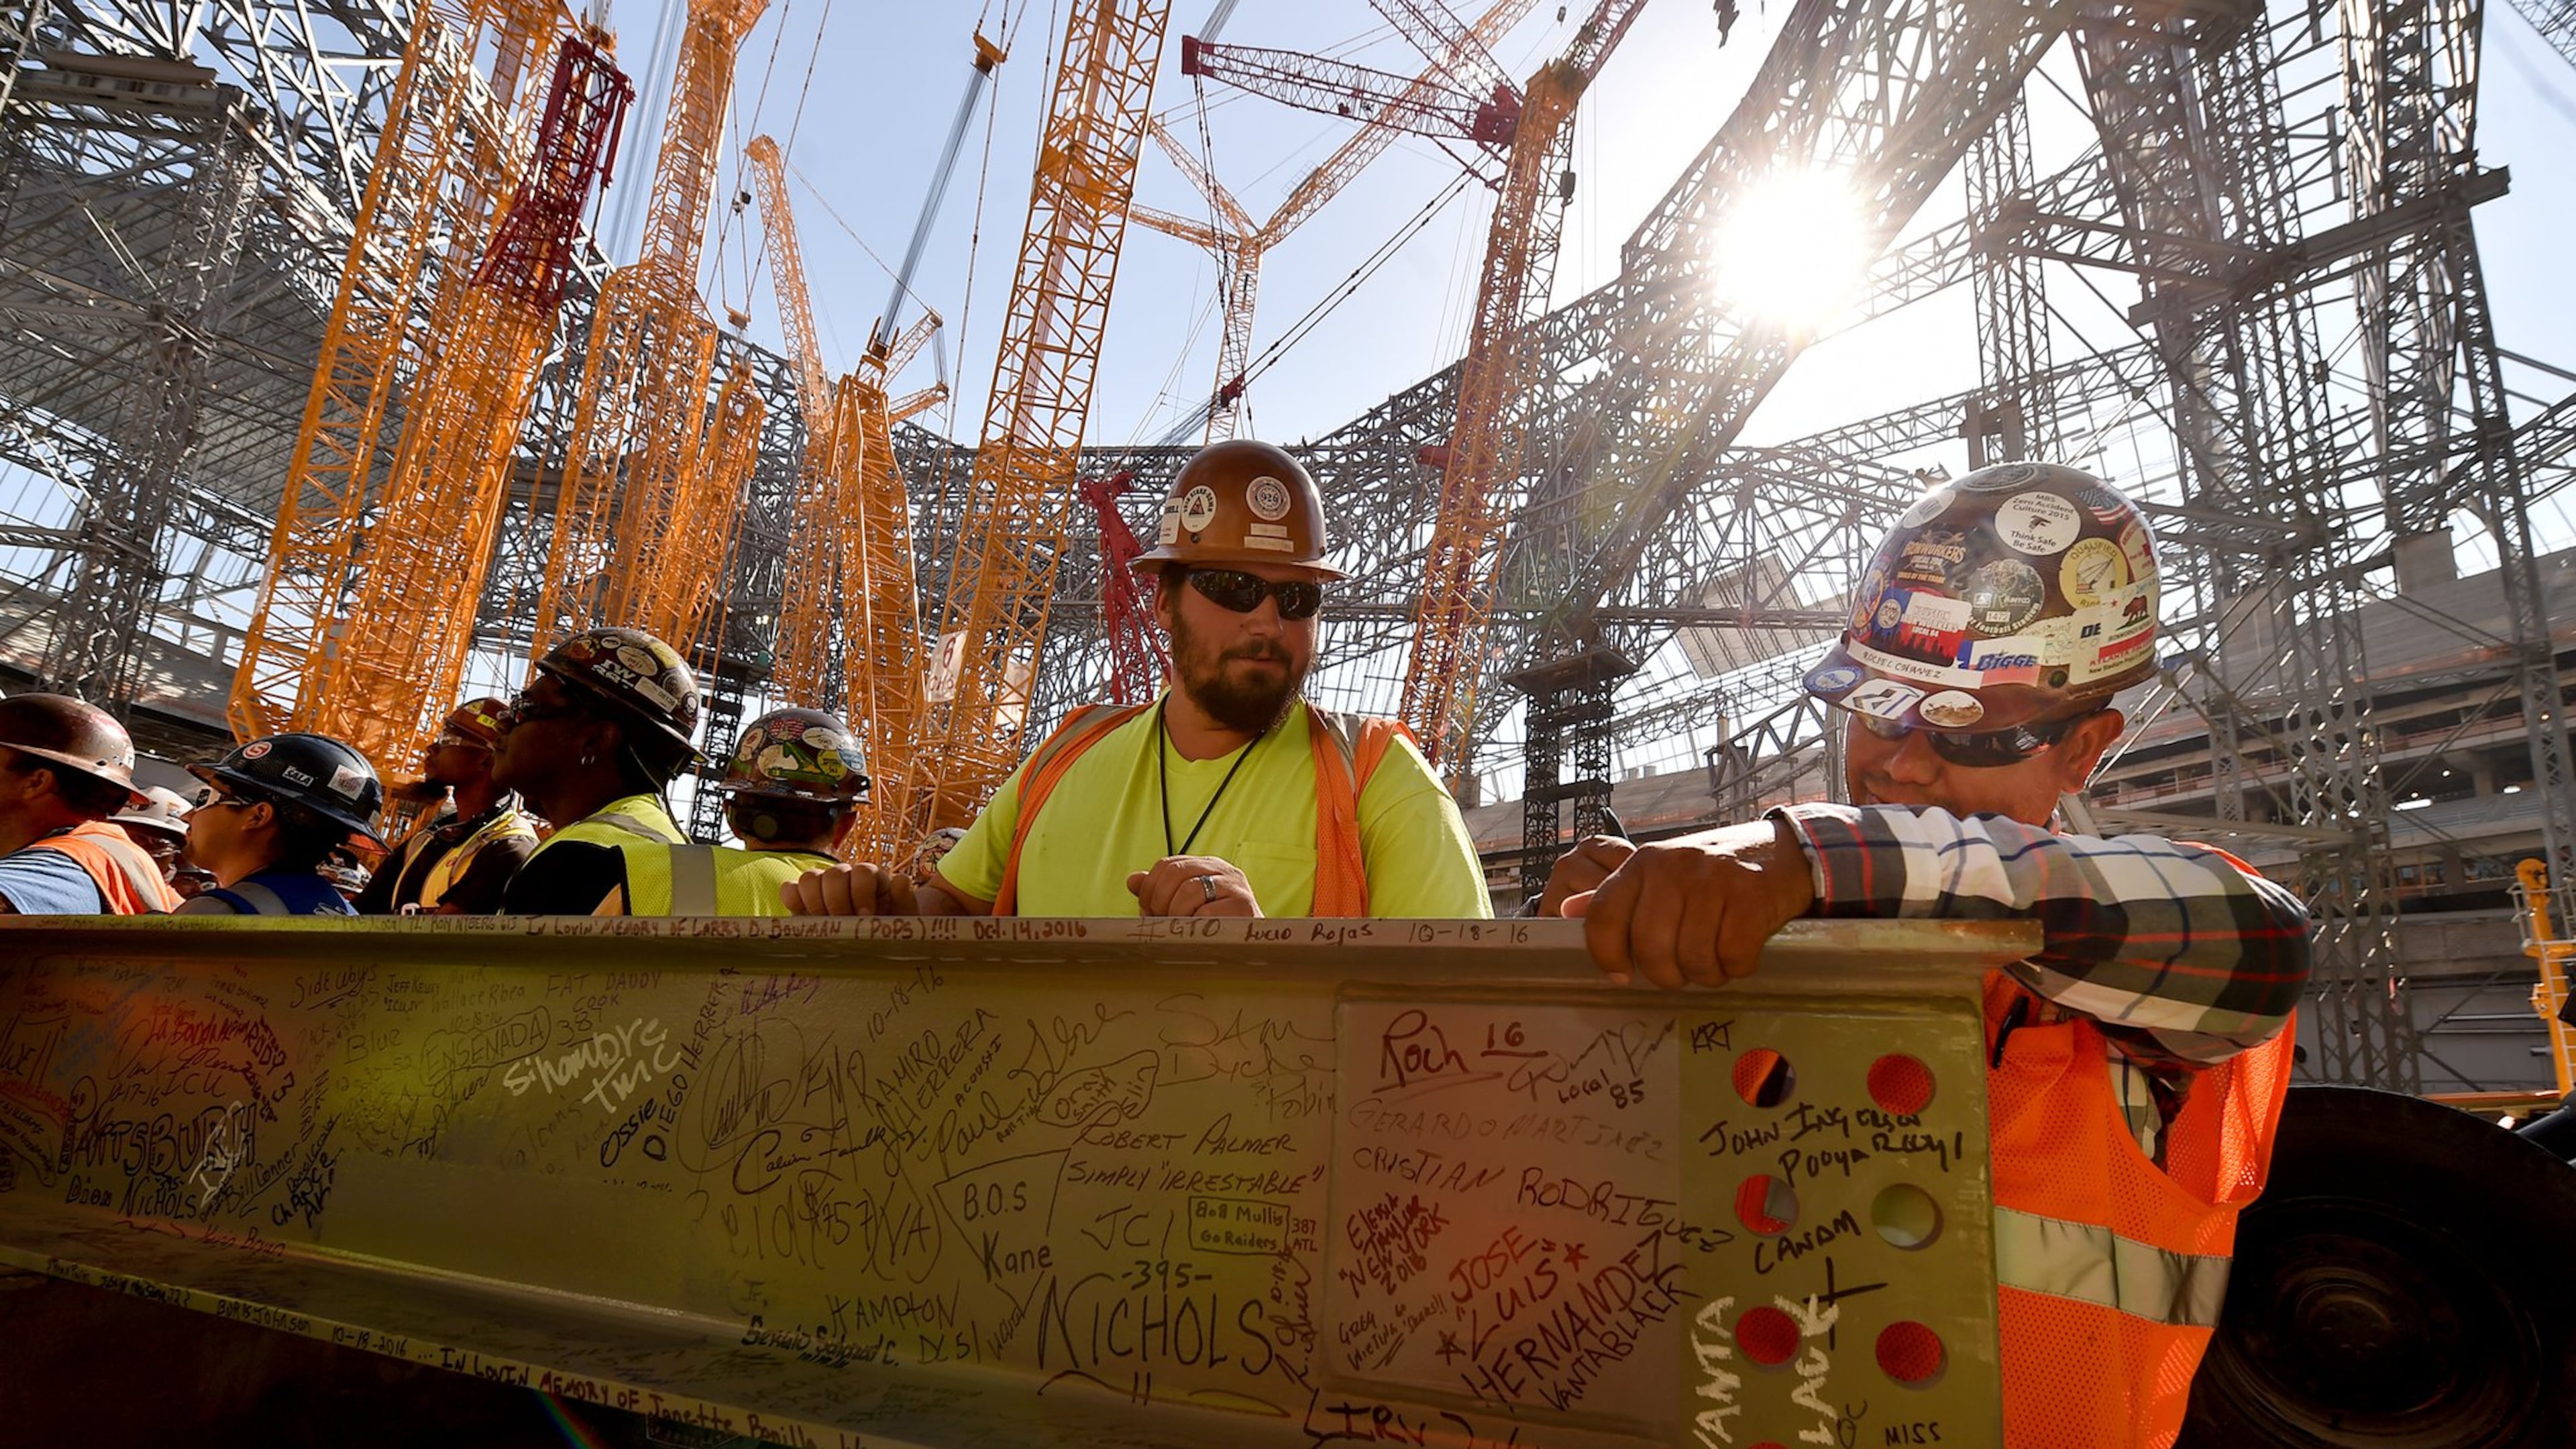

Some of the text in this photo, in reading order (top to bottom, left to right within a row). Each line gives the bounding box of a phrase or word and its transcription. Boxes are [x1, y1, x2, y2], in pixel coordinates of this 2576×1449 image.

[2012, 504, 2070, 520] Culture 2015
[2035, 500, 2074, 514] Accident
[2010, 530, 2056, 547] Think Safe
[2012, 539, 2046, 553] Be Safe
[2070, 541, 2118, 559] QUALIFIED
[525, 916, 546, 935] In
[601, 919, 659, 937] MEMORY
[670, 917, 688, 936] OF
[692, 917, 740, 938] LARRY
[749, 918, 765, 937] D.
[767, 918, 841, 938] BOWMAN
[1043, 919, 1087, 938] 2016
[1244, 923, 1374, 945] Lucio Rojas
[545, 973, 592, 999] FAT
[867, 964, 946, 1044] 10-18-16
[343, 1028, 403, 1065] Blue
[427, 1013, 545, 1084] ENSENADA
[1558, 1068, 1646, 1110] Local 85
[600, 1097, 659, 1169] Ossie
[1192, 1112, 1298, 1157] PALMER
[1348, 1097, 1498, 1140] GERARDO
[1699, 1119, 1780, 1159] JOHN
[1067, 1160, 1152, 1193] SIMPLY
[1352, 1146, 1735, 1252] CRISTIAN RODRIGUEZ
[1223, 1232, 1279, 1252] Raiders
[1291, 1216, 1318, 1236] 387
[982, 1230, 1054, 1284] Kane
[1291, 1235, 1319, 1254] ATL
[1037, 1275, 1274, 1376] NICHOLS
[1460, 1228, 1662, 1415] HERNANDEZ
[438, 1346, 466, 1373] IN
[539, 1371, 610, 1405] MEMORY
[617, 1390, 640, 1407] OF
[1884, 1421, 1943, 1447] MISS
